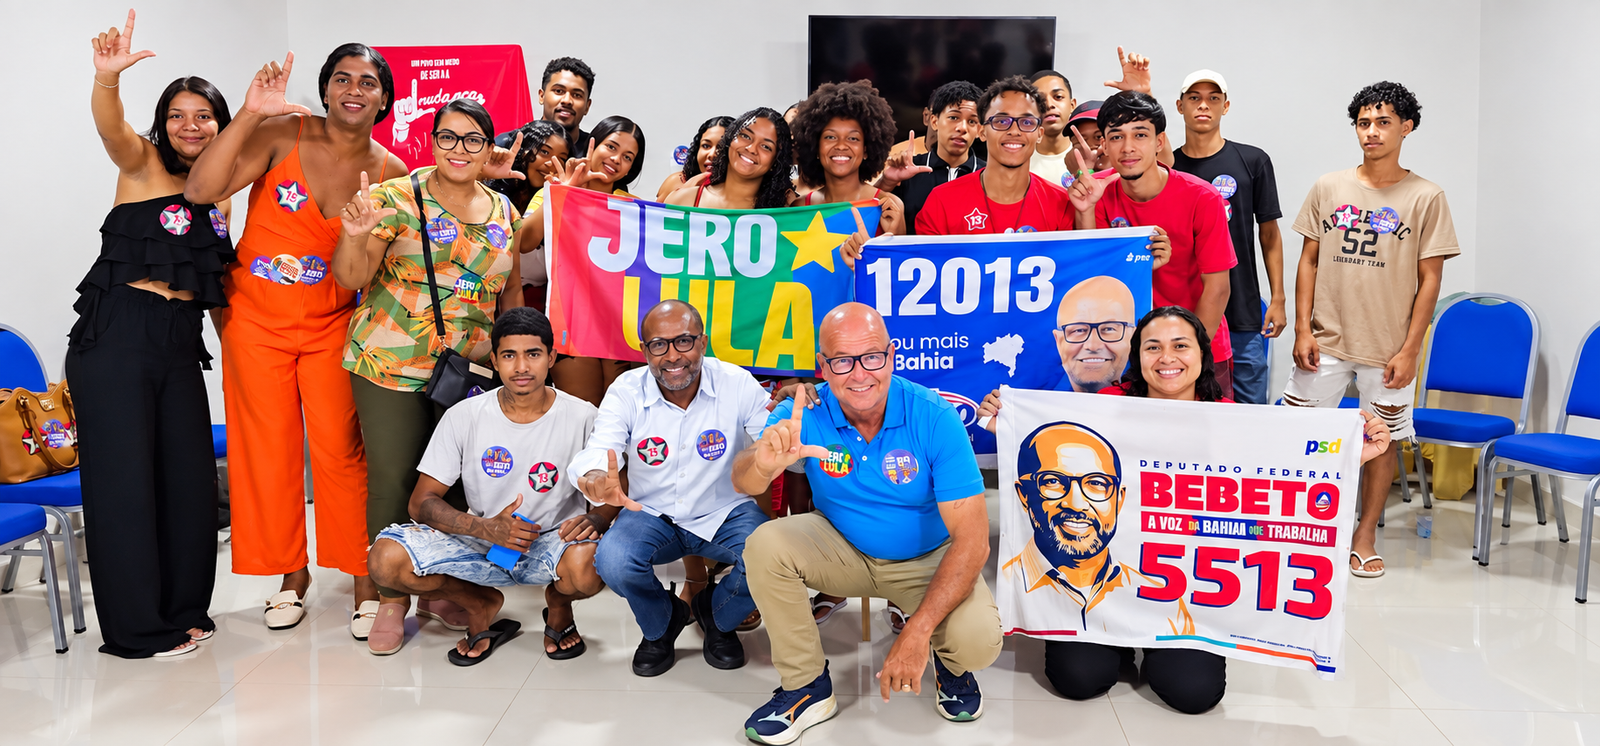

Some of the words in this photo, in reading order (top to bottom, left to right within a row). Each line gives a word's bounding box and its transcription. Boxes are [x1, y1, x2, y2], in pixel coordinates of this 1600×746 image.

[420, 70, 428, 80] DE
[970, 216, 982, 226] 13
[587, 197, 778, 278] JERO
[1342, 228, 1378, 257] 52
[866, 255, 1056, 317] 12013
[920, 332, 969, 349] mais
[896, 352, 954, 370] Bahia
[1305, 438, 1342, 456] psd
[1140, 459, 1242, 474] DEPUTADO
[1256, 466, 1342, 480] FEDERAL
[1140, 471, 1340, 521] BEBETO
[1148, 515, 1156, 530] A
[1160, 516, 1183, 532] VOZ
[1188, 520, 1200, 531] DA
[1268, 524, 1328, 544] TRABALHA
[1136, 542, 1334, 620] 5513
